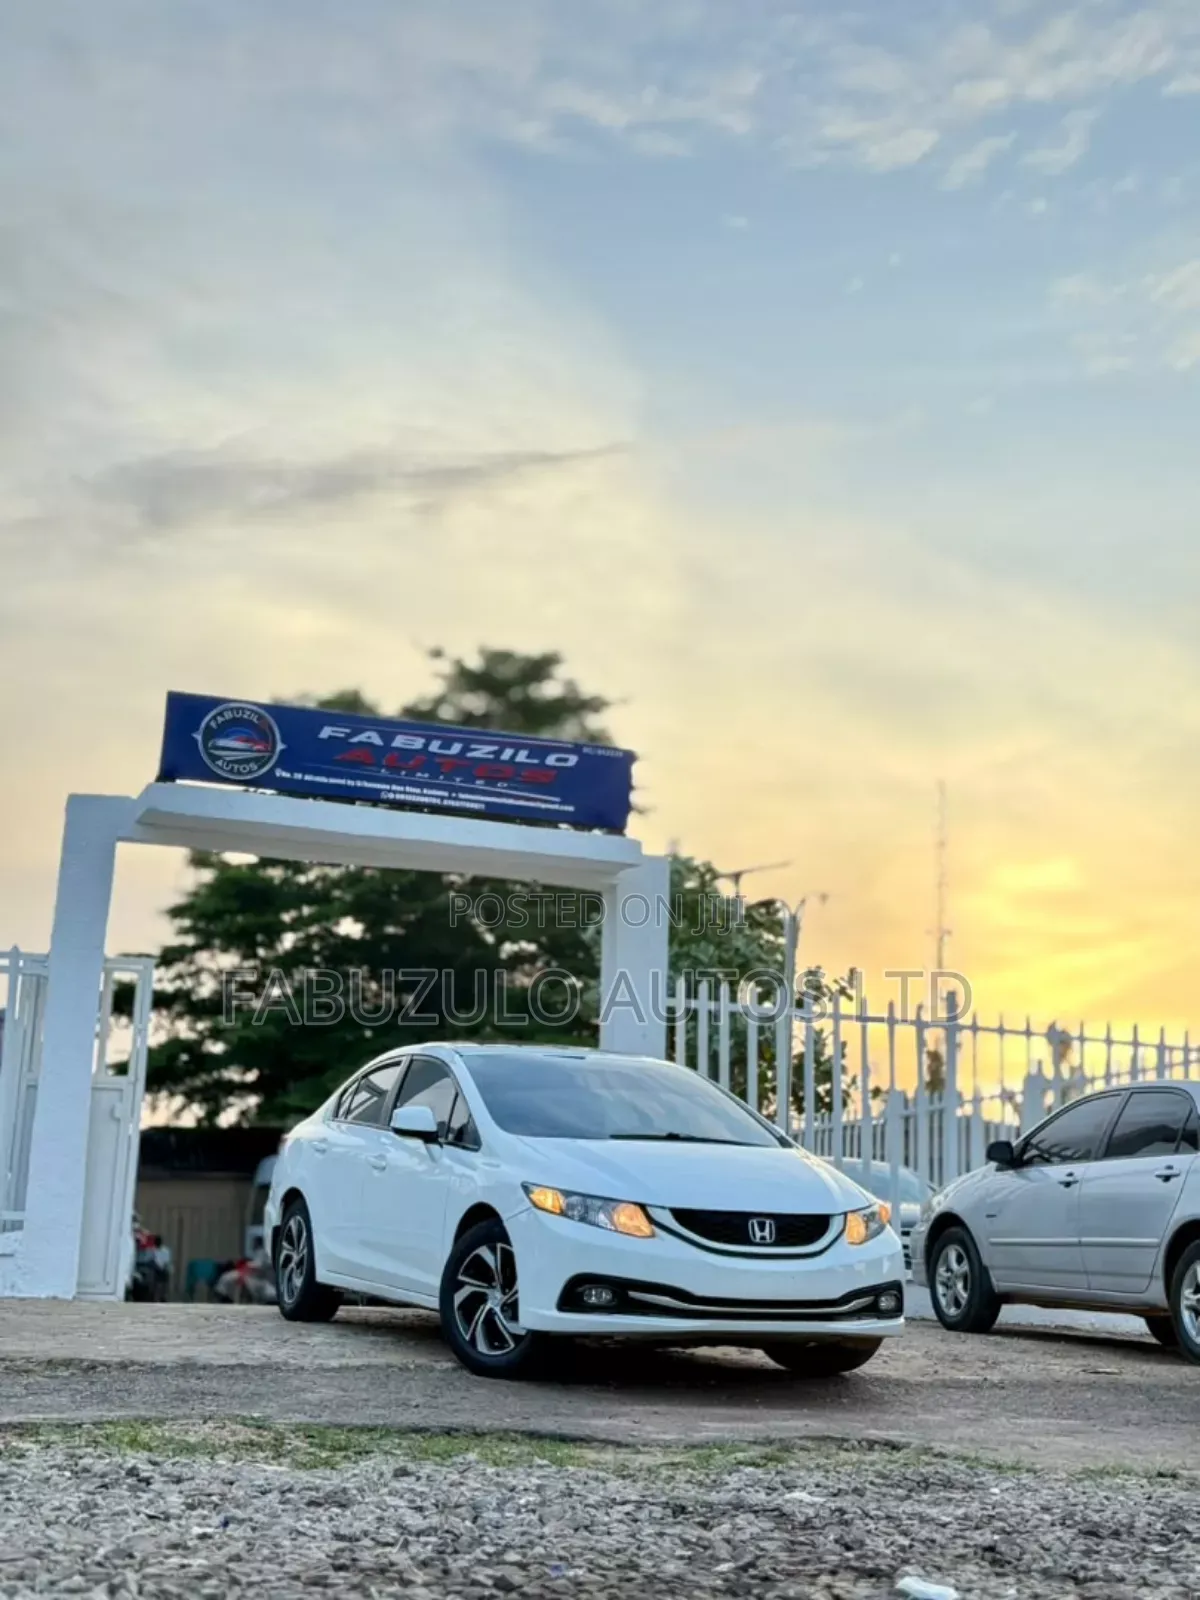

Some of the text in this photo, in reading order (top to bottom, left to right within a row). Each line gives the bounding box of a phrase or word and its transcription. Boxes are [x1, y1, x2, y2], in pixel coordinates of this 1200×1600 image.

[317, 726, 579, 767] FABUZILO
[215, 760, 258, 773] AUTOS
[333, 748, 557, 783] AUTOS
